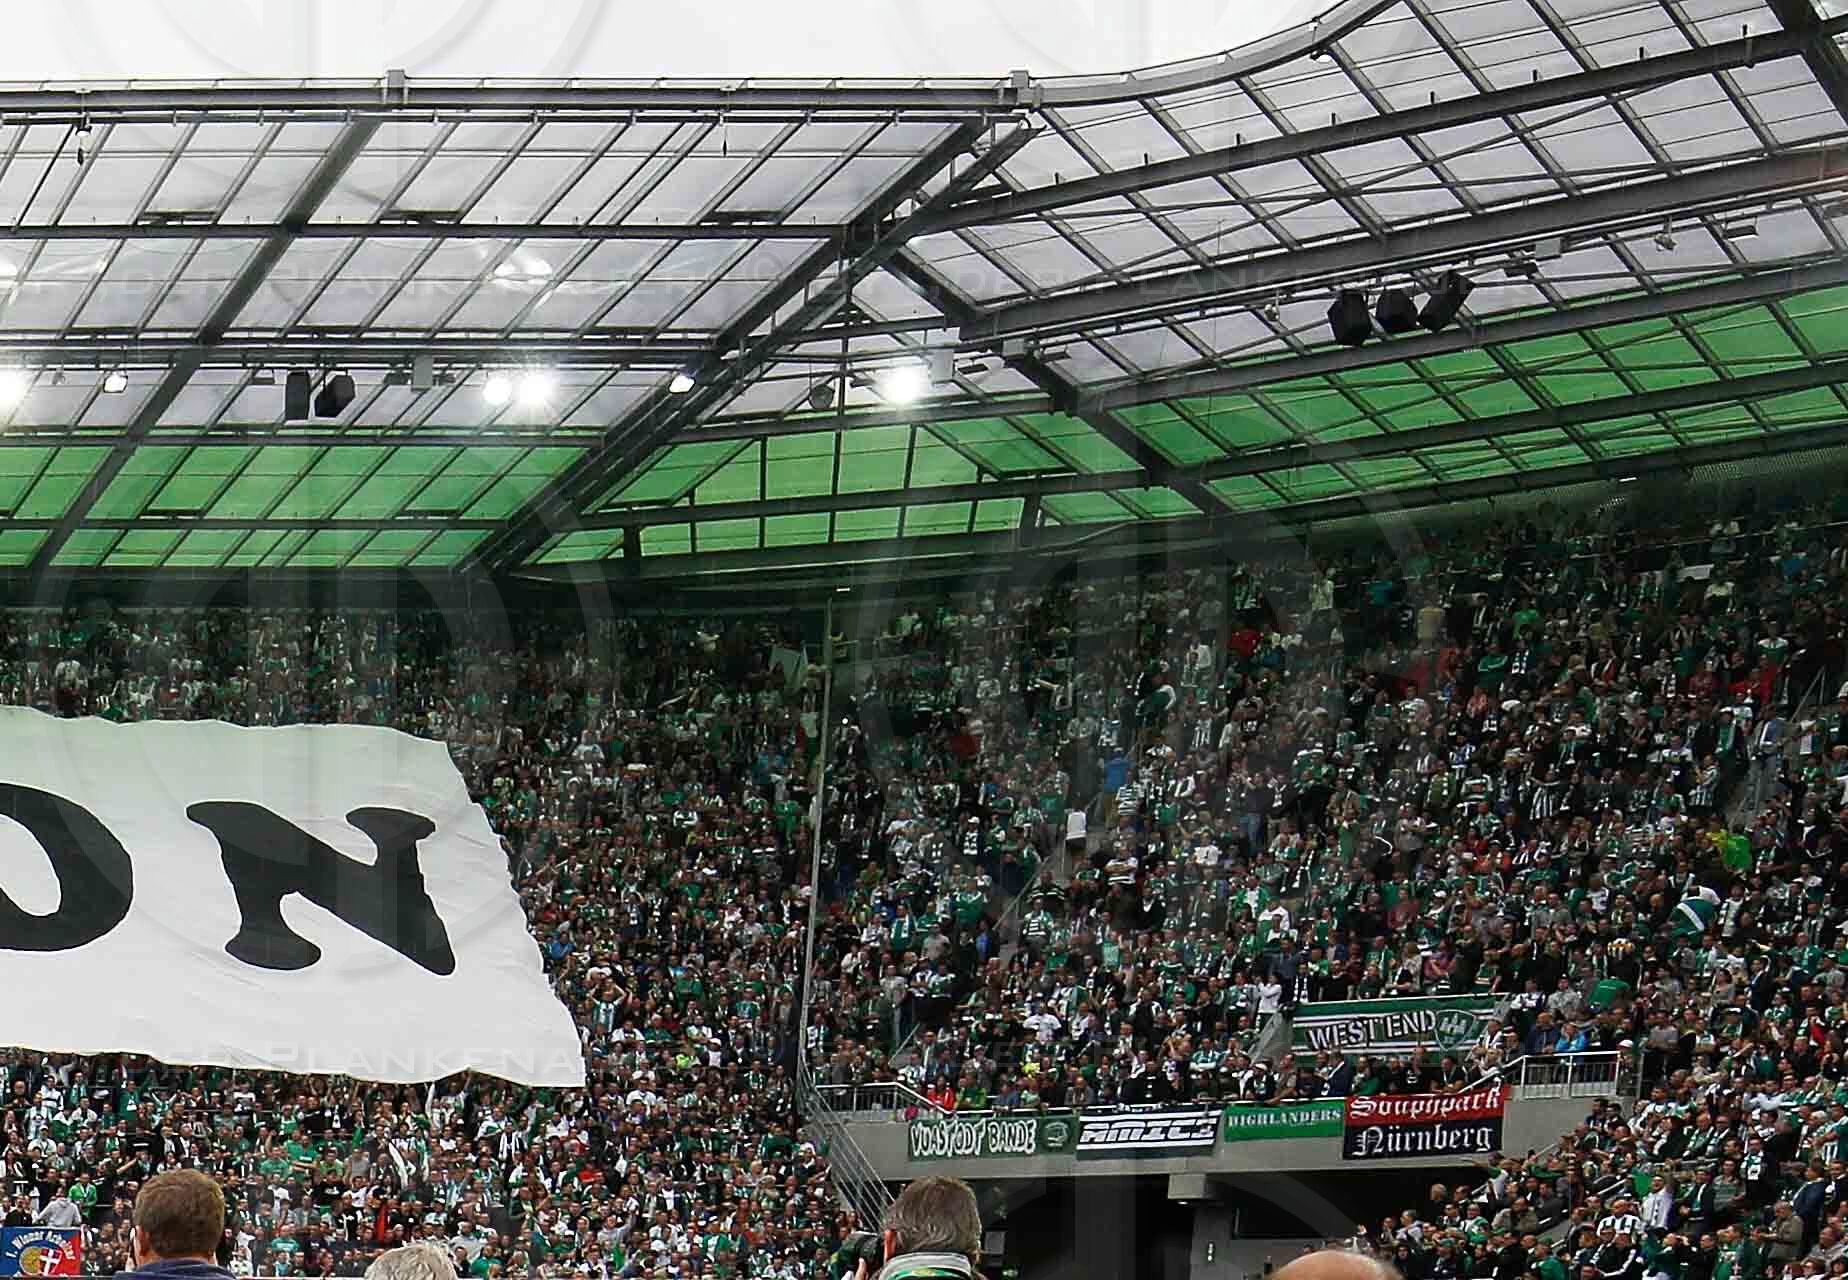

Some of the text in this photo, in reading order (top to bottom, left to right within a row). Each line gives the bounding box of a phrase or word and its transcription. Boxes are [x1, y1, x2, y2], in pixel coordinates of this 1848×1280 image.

[1386, 1010, 1436, 1038] END
[1228, 1110, 1342, 1128] HIGHLANDERS
[987, 1118, 1037, 1155] BANDE
[1352, 1122, 1495, 1157] Nürnberg
